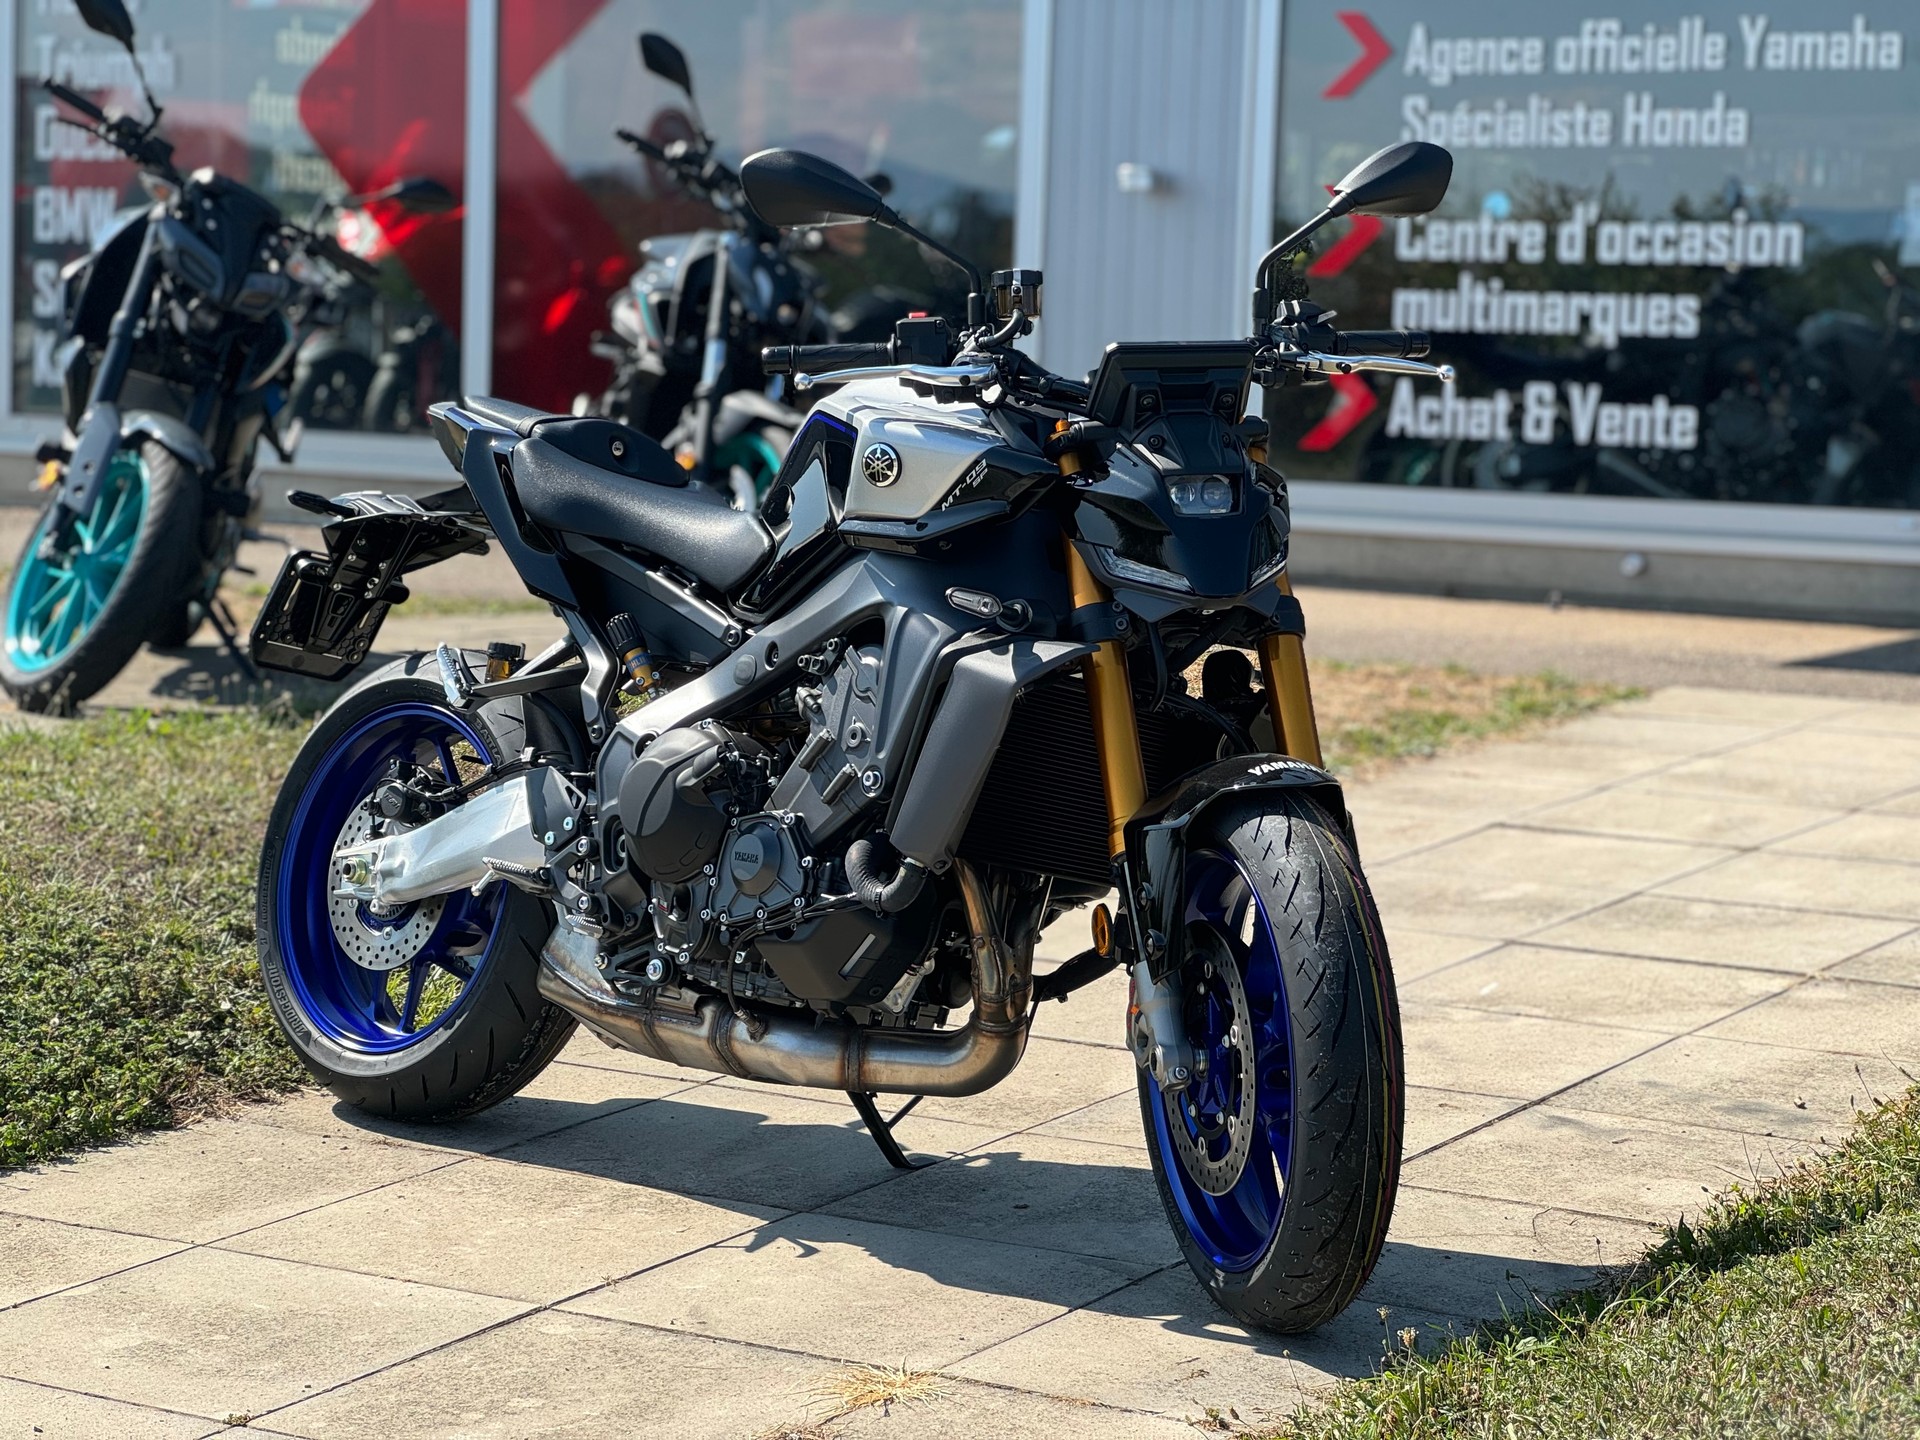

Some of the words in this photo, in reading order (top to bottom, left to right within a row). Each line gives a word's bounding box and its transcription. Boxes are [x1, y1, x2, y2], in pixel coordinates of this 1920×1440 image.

[1404, 22, 1544, 86] Agence
[1554, 16, 1726, 75] officielle
[1738, 14, 1903, 70] Yamaha
[1401, 93, 1612, 148] Spécialiste
[1624, 92, 1749, 147] Honda
[33, 187, 118, 244] BMW
[1395, 212, 1547, 264] Centre
[1555, 202, 1804, 268] d'occasion
[1390, 270, 1701, 350] multimarques
[1385, 376, 1513, 441] Achat
[1521, 380, 1557, 445] &
[1566, 382, 1700, 450] Vente
[941, 458, 987, 512] MT-09
[972, 467, 988, 488] SP
[734, 850, 759, 864] YAMAHA
[266, 961, 309, 1037] BRIDGESTONE
